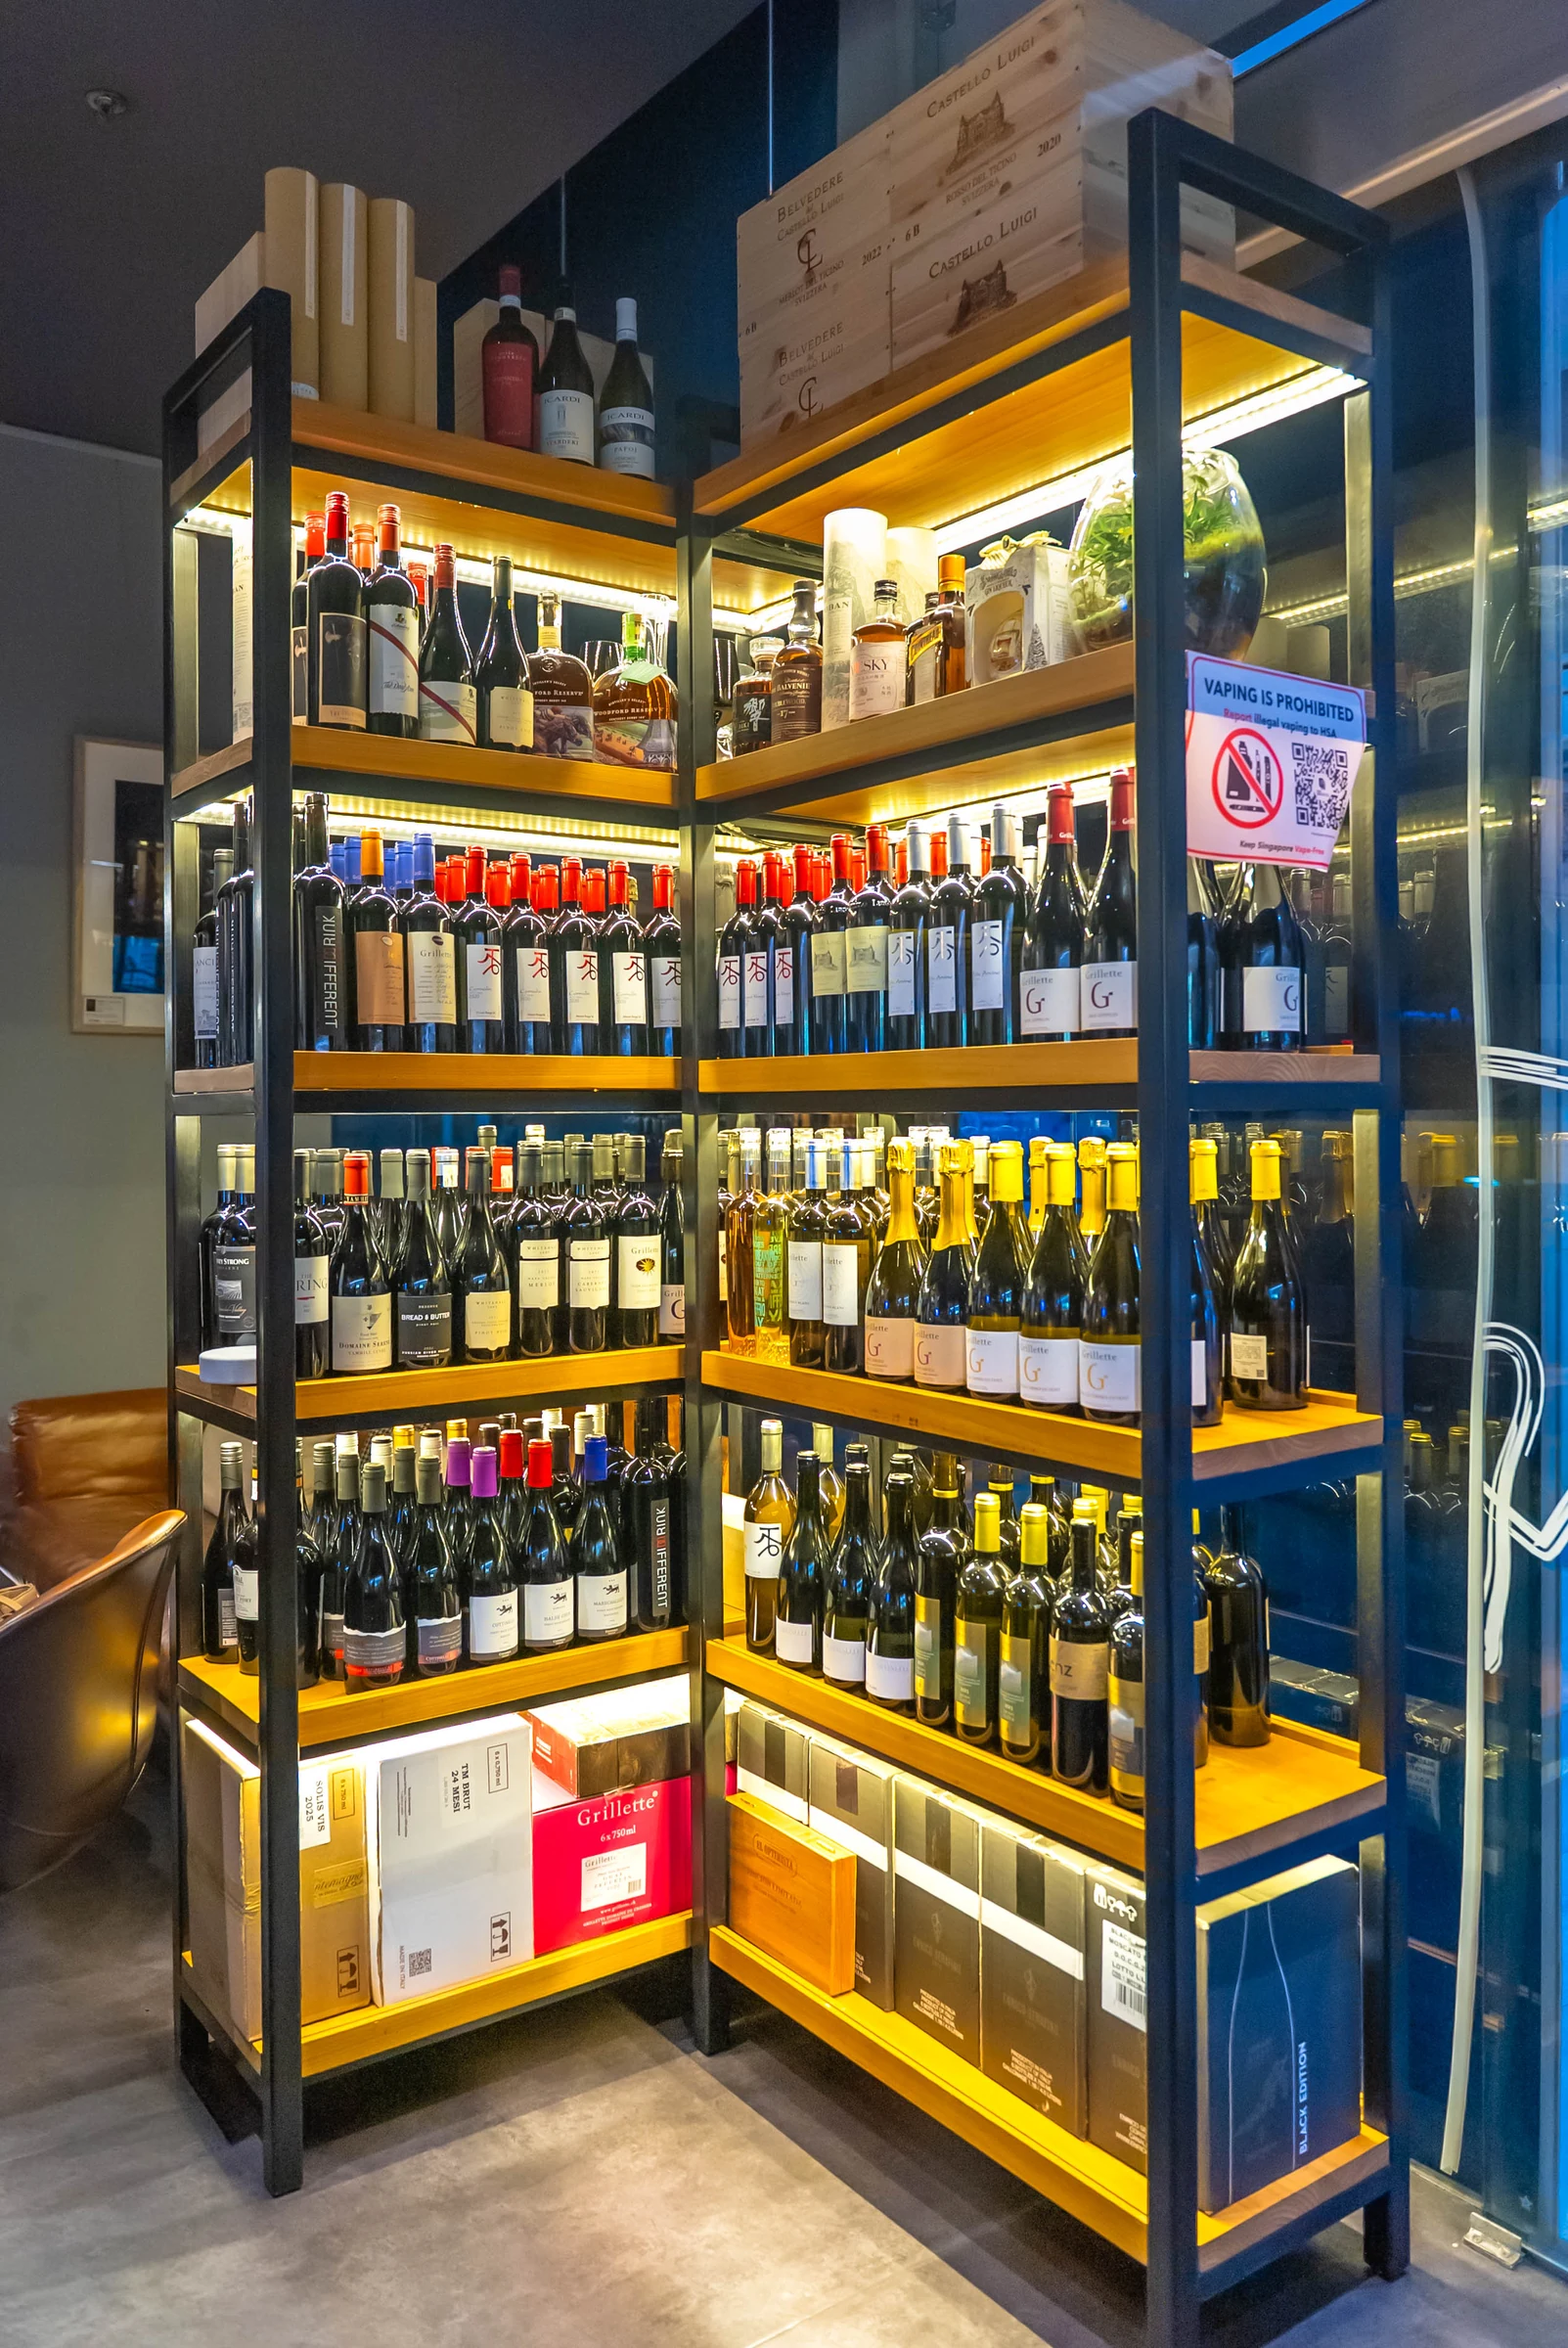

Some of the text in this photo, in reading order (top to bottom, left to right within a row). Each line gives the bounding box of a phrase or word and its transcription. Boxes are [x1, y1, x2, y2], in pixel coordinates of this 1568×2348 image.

[927, 37, 1034, 118] CASTELLO LUIGI
[1037, 133, 1061, 158] 2020
[989, 153, 1017, 177] TICINO
[778, 171, 843, 223] BELVEDERE
[929, 207, 1037, 279] CASTELLO LUIGI
[862, 247, 881, 265] 2022
[780, 322, 843, 367] BELVEDERE
[544, 395, 581, 405] ICARDI
[829, 601, 849, 611] BAN
[1204, 678, 1354, 722] VAPING IS PROHIBITED
[1224, 708, 1337, 738] Report illegal vaping to HSA
[1239, 840, 1256, 851] Keep
[1258, 841, 1293, 853] Singapore
[430, 1311, 450, 1320] BUTTER
[452, 1771, 459, 1783] 24
[462, 1763, 469, 1780] TM
[577, 1792, 656, 1827] Grillette
[315, 1868, 363, 1890] ntemagno
[1109, 1937, 1142, 1959] MOSCATO
[1112, 1961, 1134, 1977] LOTTO
[1298, 2041, 1308, 2154] BLACK EDITION
